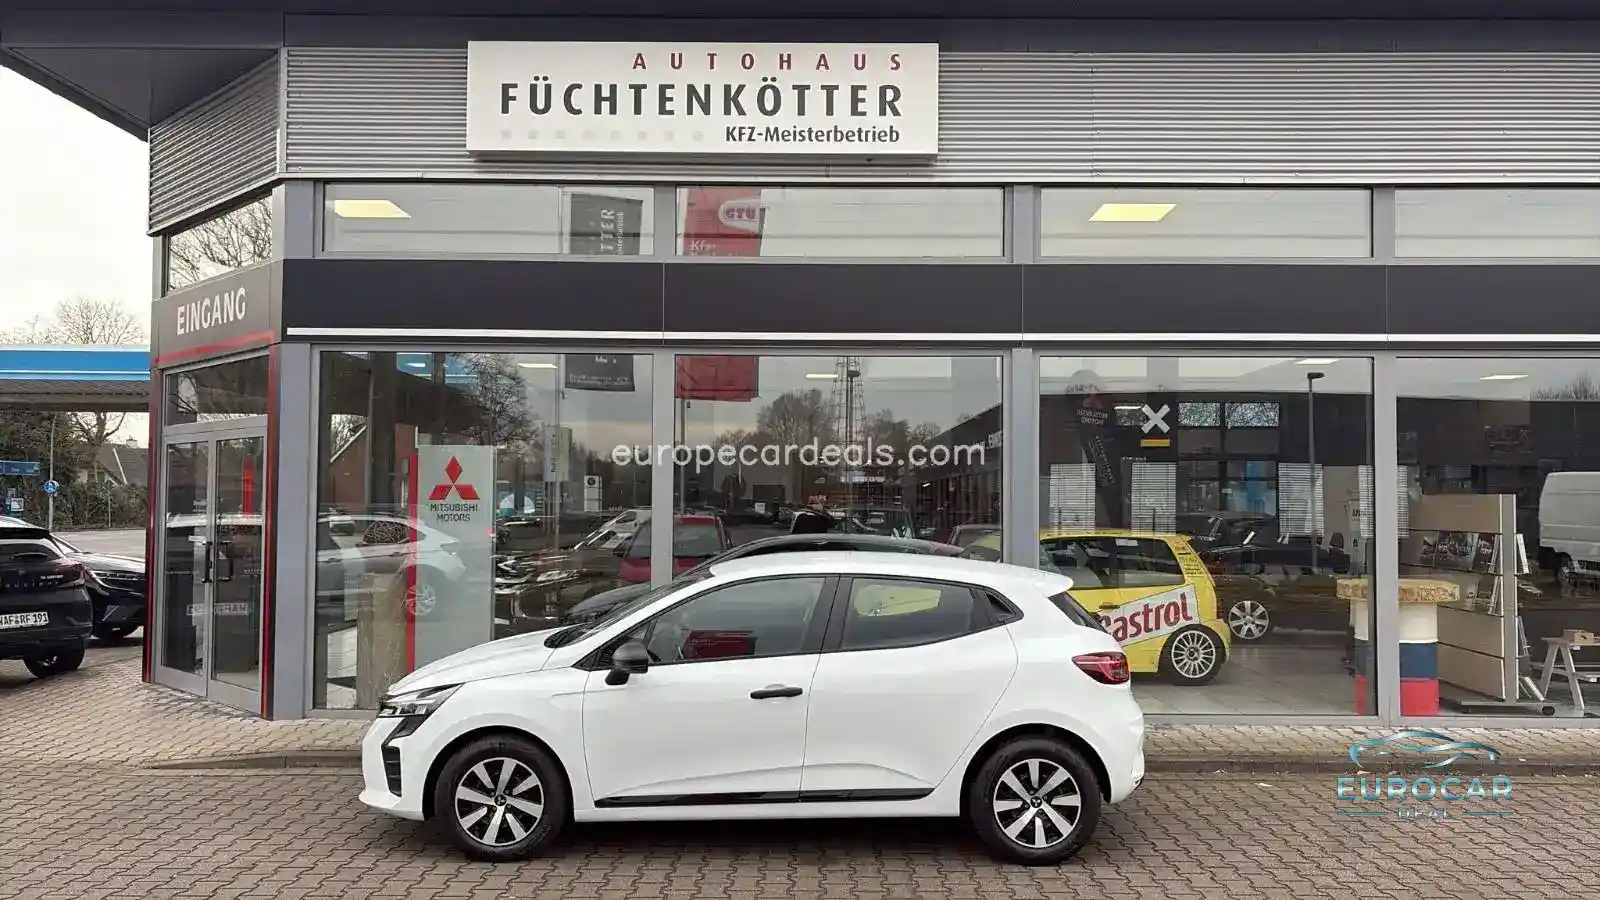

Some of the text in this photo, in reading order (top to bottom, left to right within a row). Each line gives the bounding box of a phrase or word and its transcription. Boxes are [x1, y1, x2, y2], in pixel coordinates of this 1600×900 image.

[633, 52, 902, 71] AUTOHAUS
[500, 75, 902, 117] FÜCHTENKÖTTER
[725, 125, 900, 143] KFZ-Meisterbetrieb
[176, 286, 247, 336] EINGANG
[430, 503, 478, 512] MITSUBISHI
[436, 513, 471, 522] MOTORS
[32, 612, 48, 623] 191
